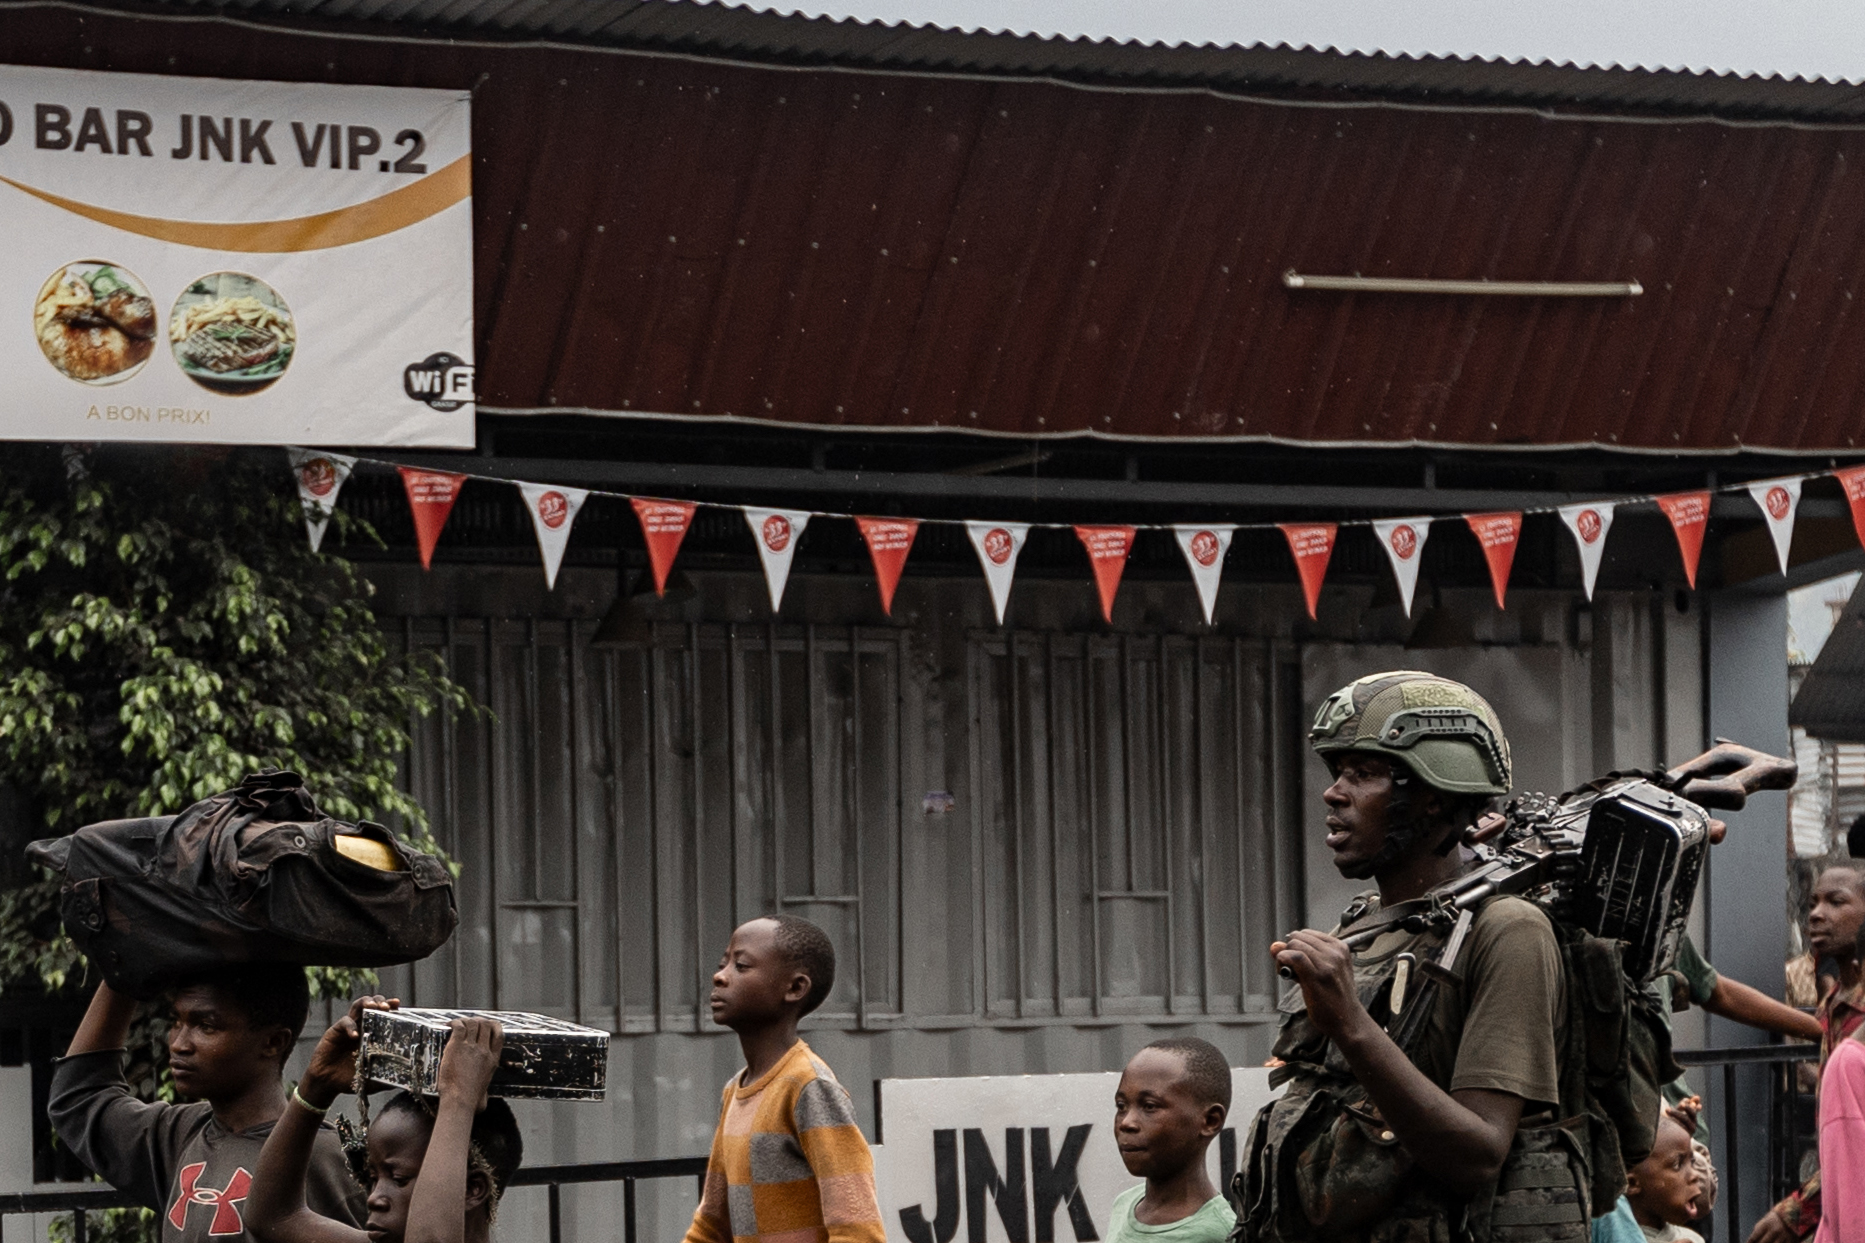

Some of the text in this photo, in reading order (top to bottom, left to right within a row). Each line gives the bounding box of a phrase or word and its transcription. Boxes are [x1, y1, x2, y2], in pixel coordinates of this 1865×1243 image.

[34, 102, 154, 157] BAR
[171, 113, 277, 165] JNK
[290, 121, 428, 174] VIP.2
[86, 404, 211, 425] A BON PRIX!
